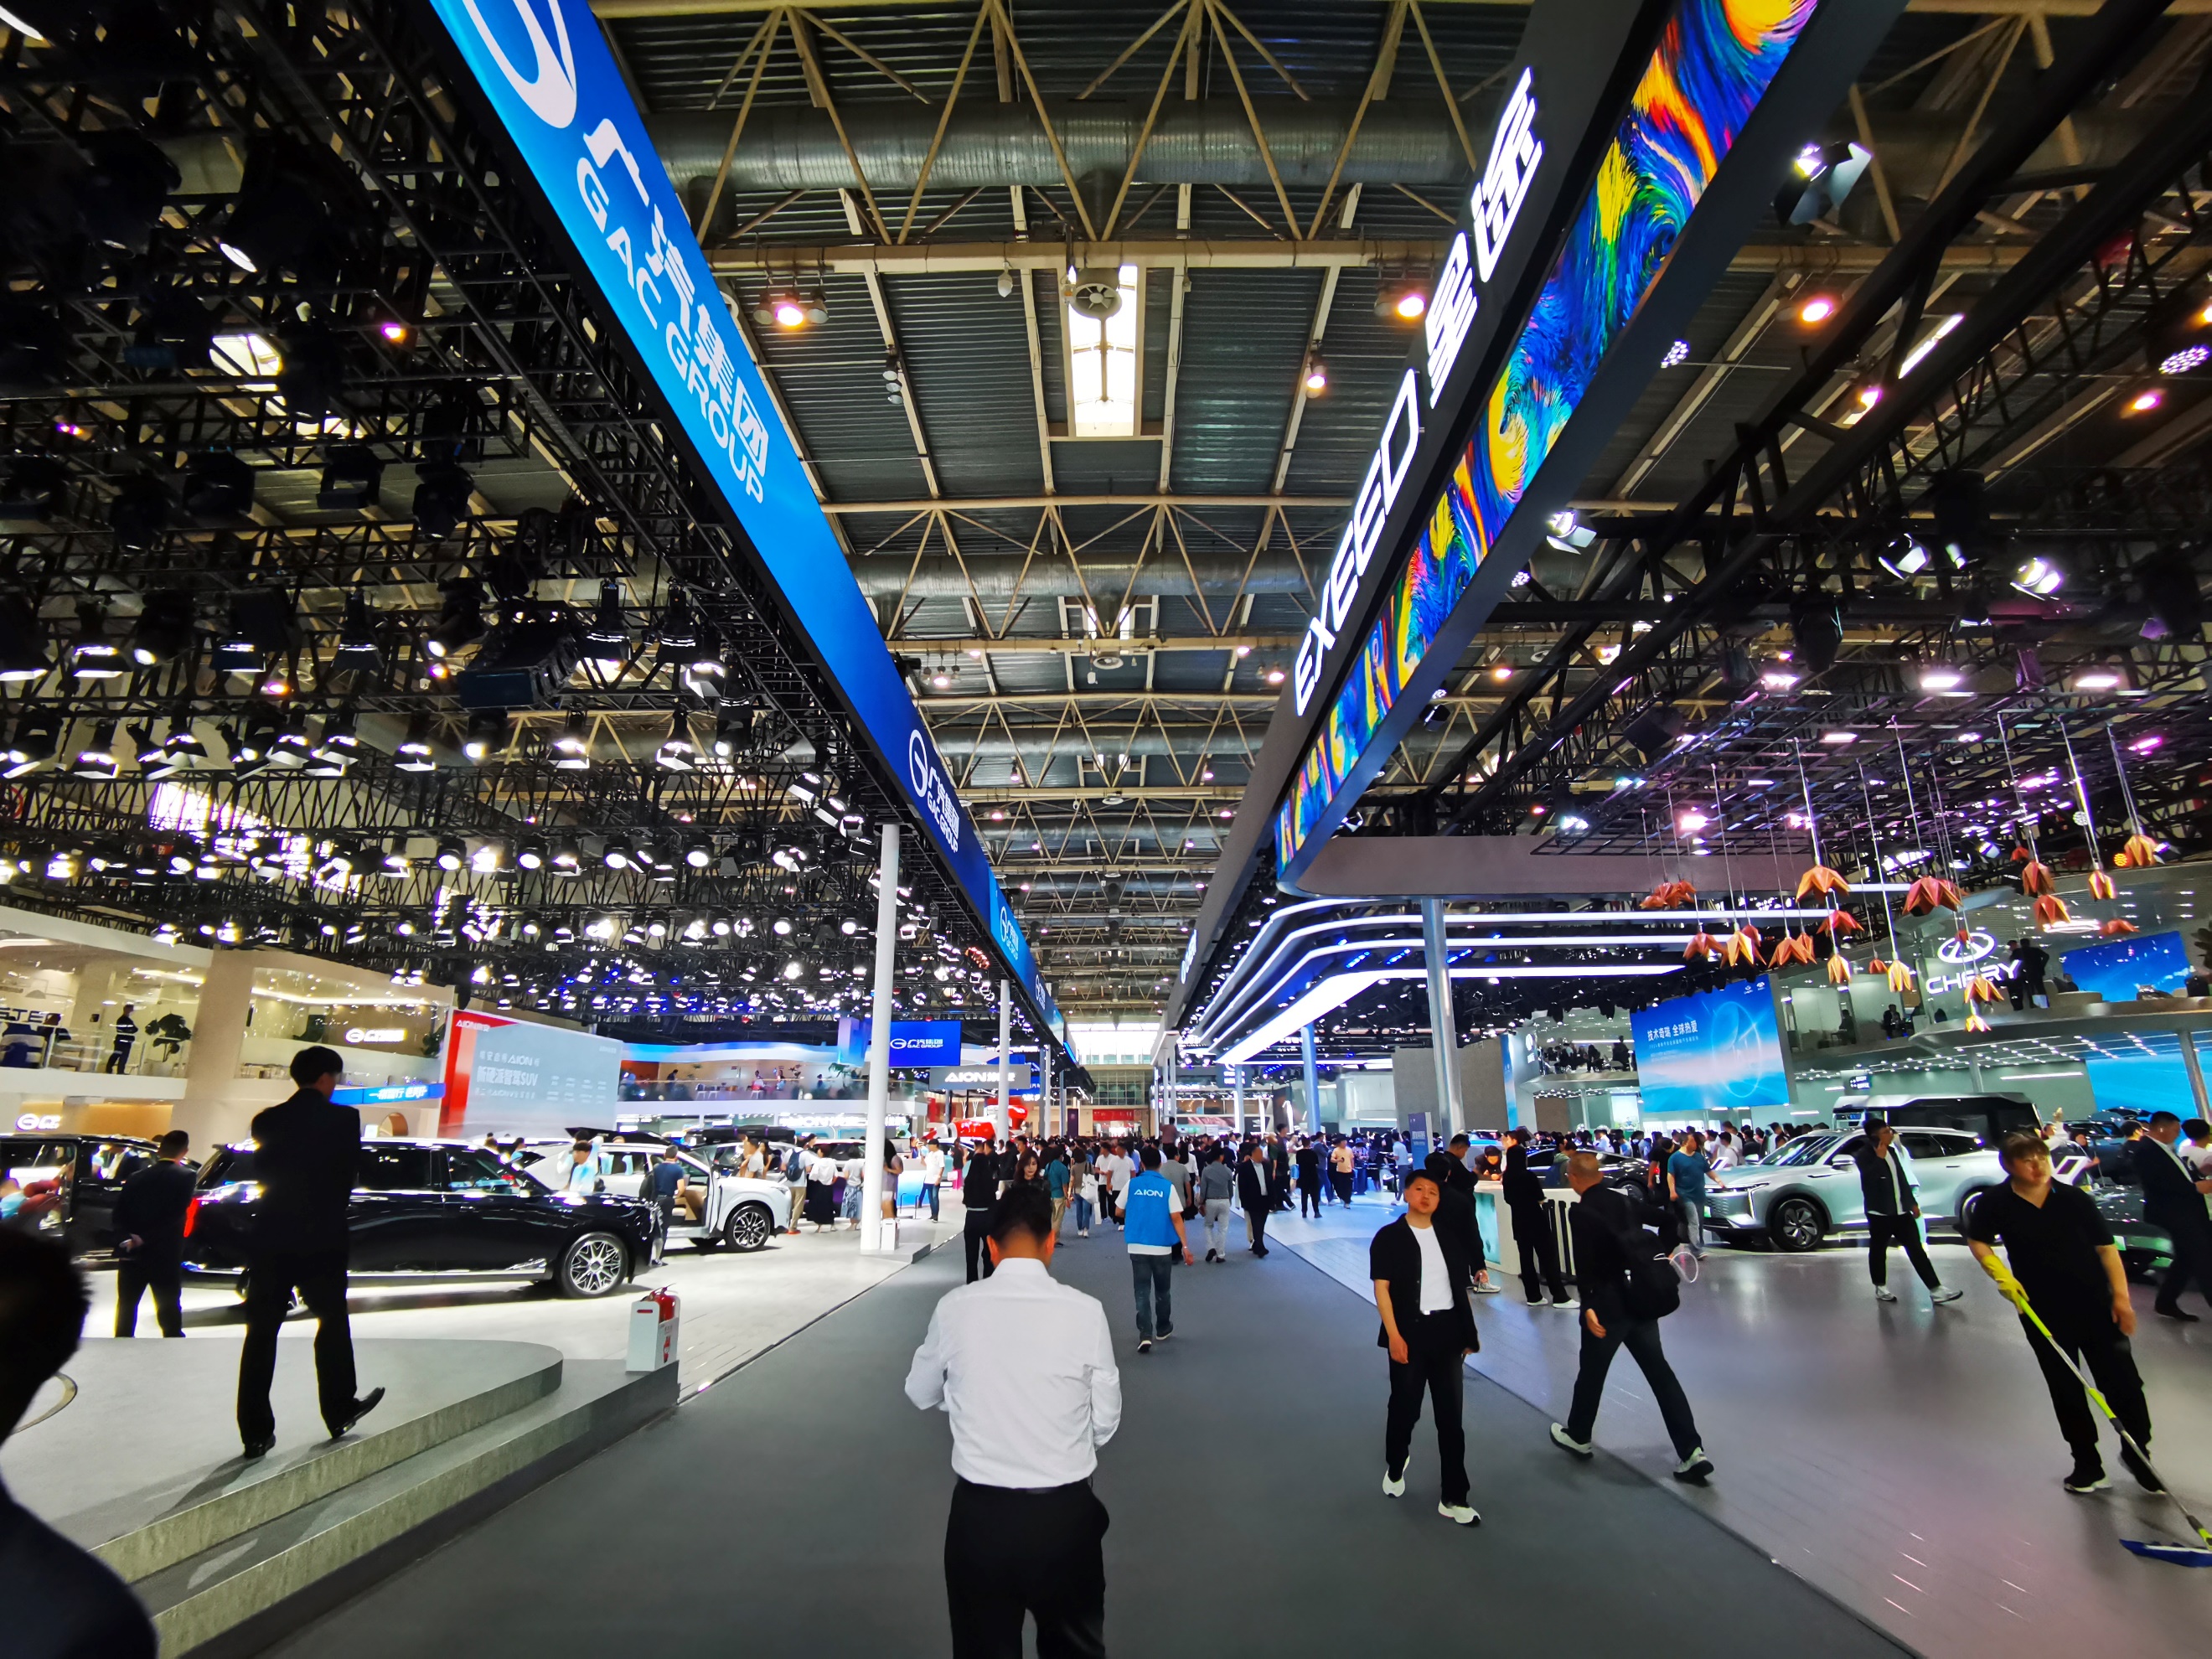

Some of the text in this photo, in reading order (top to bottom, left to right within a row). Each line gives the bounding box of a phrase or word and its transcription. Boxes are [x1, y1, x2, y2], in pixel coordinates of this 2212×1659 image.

[576, 157, 763, 504] GAC GROUP
[584, 118, 769, 477] 广汽集团
[1295, 66, 1543, 716] EXEED 星途
[927, 790, 959, 853] GAC GROUP
[928, 766, 960, 840] 广汽集团
[1672, 1020, 1698, 1036] 全球热爱
[1134, 1188, 1164, 1198] AION
